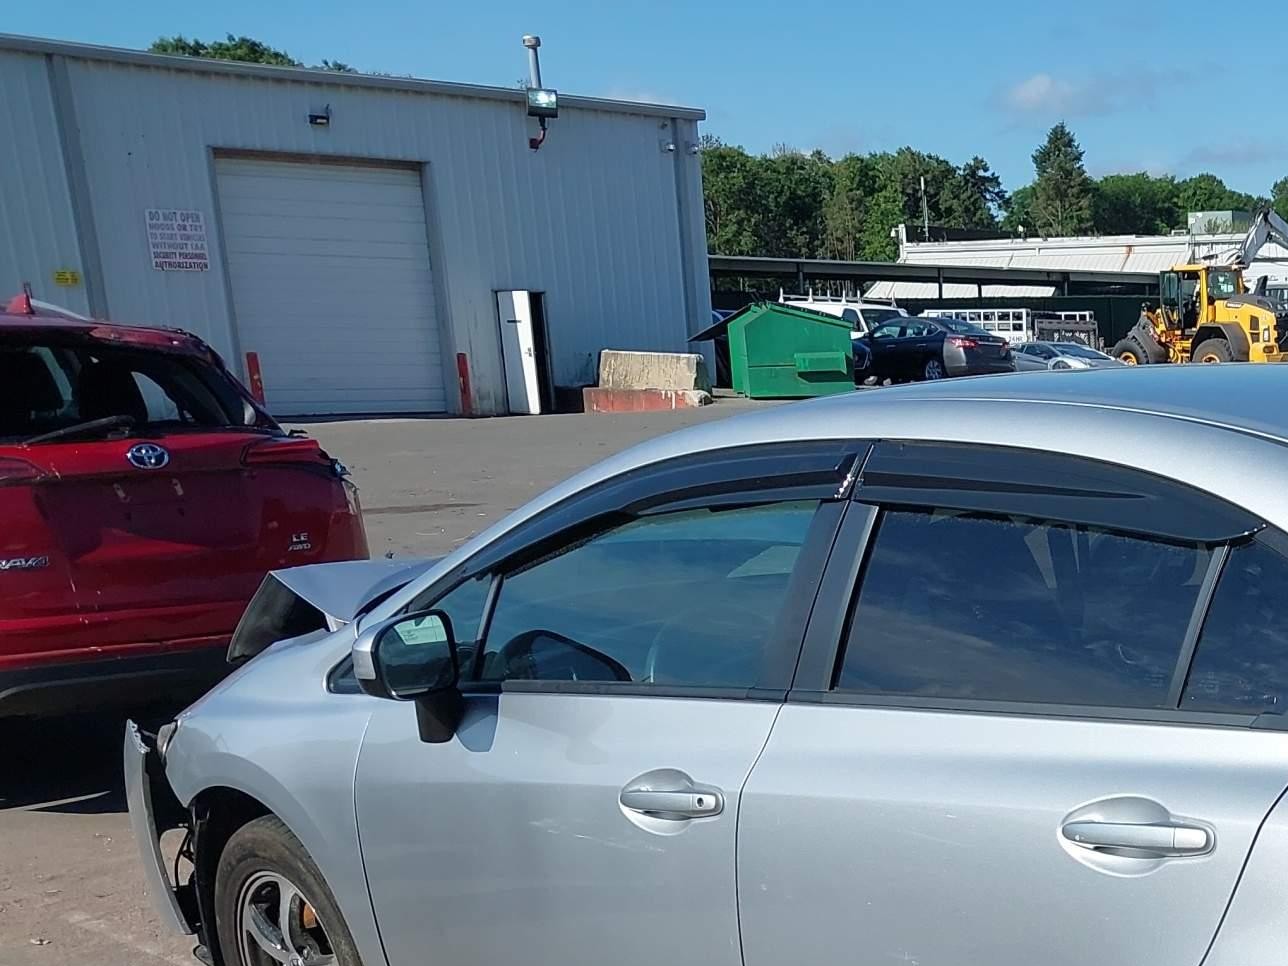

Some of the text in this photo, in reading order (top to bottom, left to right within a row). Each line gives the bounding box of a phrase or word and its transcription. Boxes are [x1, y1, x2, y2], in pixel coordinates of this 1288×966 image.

[149, 211, 201, 223] DO NOT OPEN
[152, 241, 188, 250] WITHOUT
[155, 260, 209, 270] AUTHORIZATION
